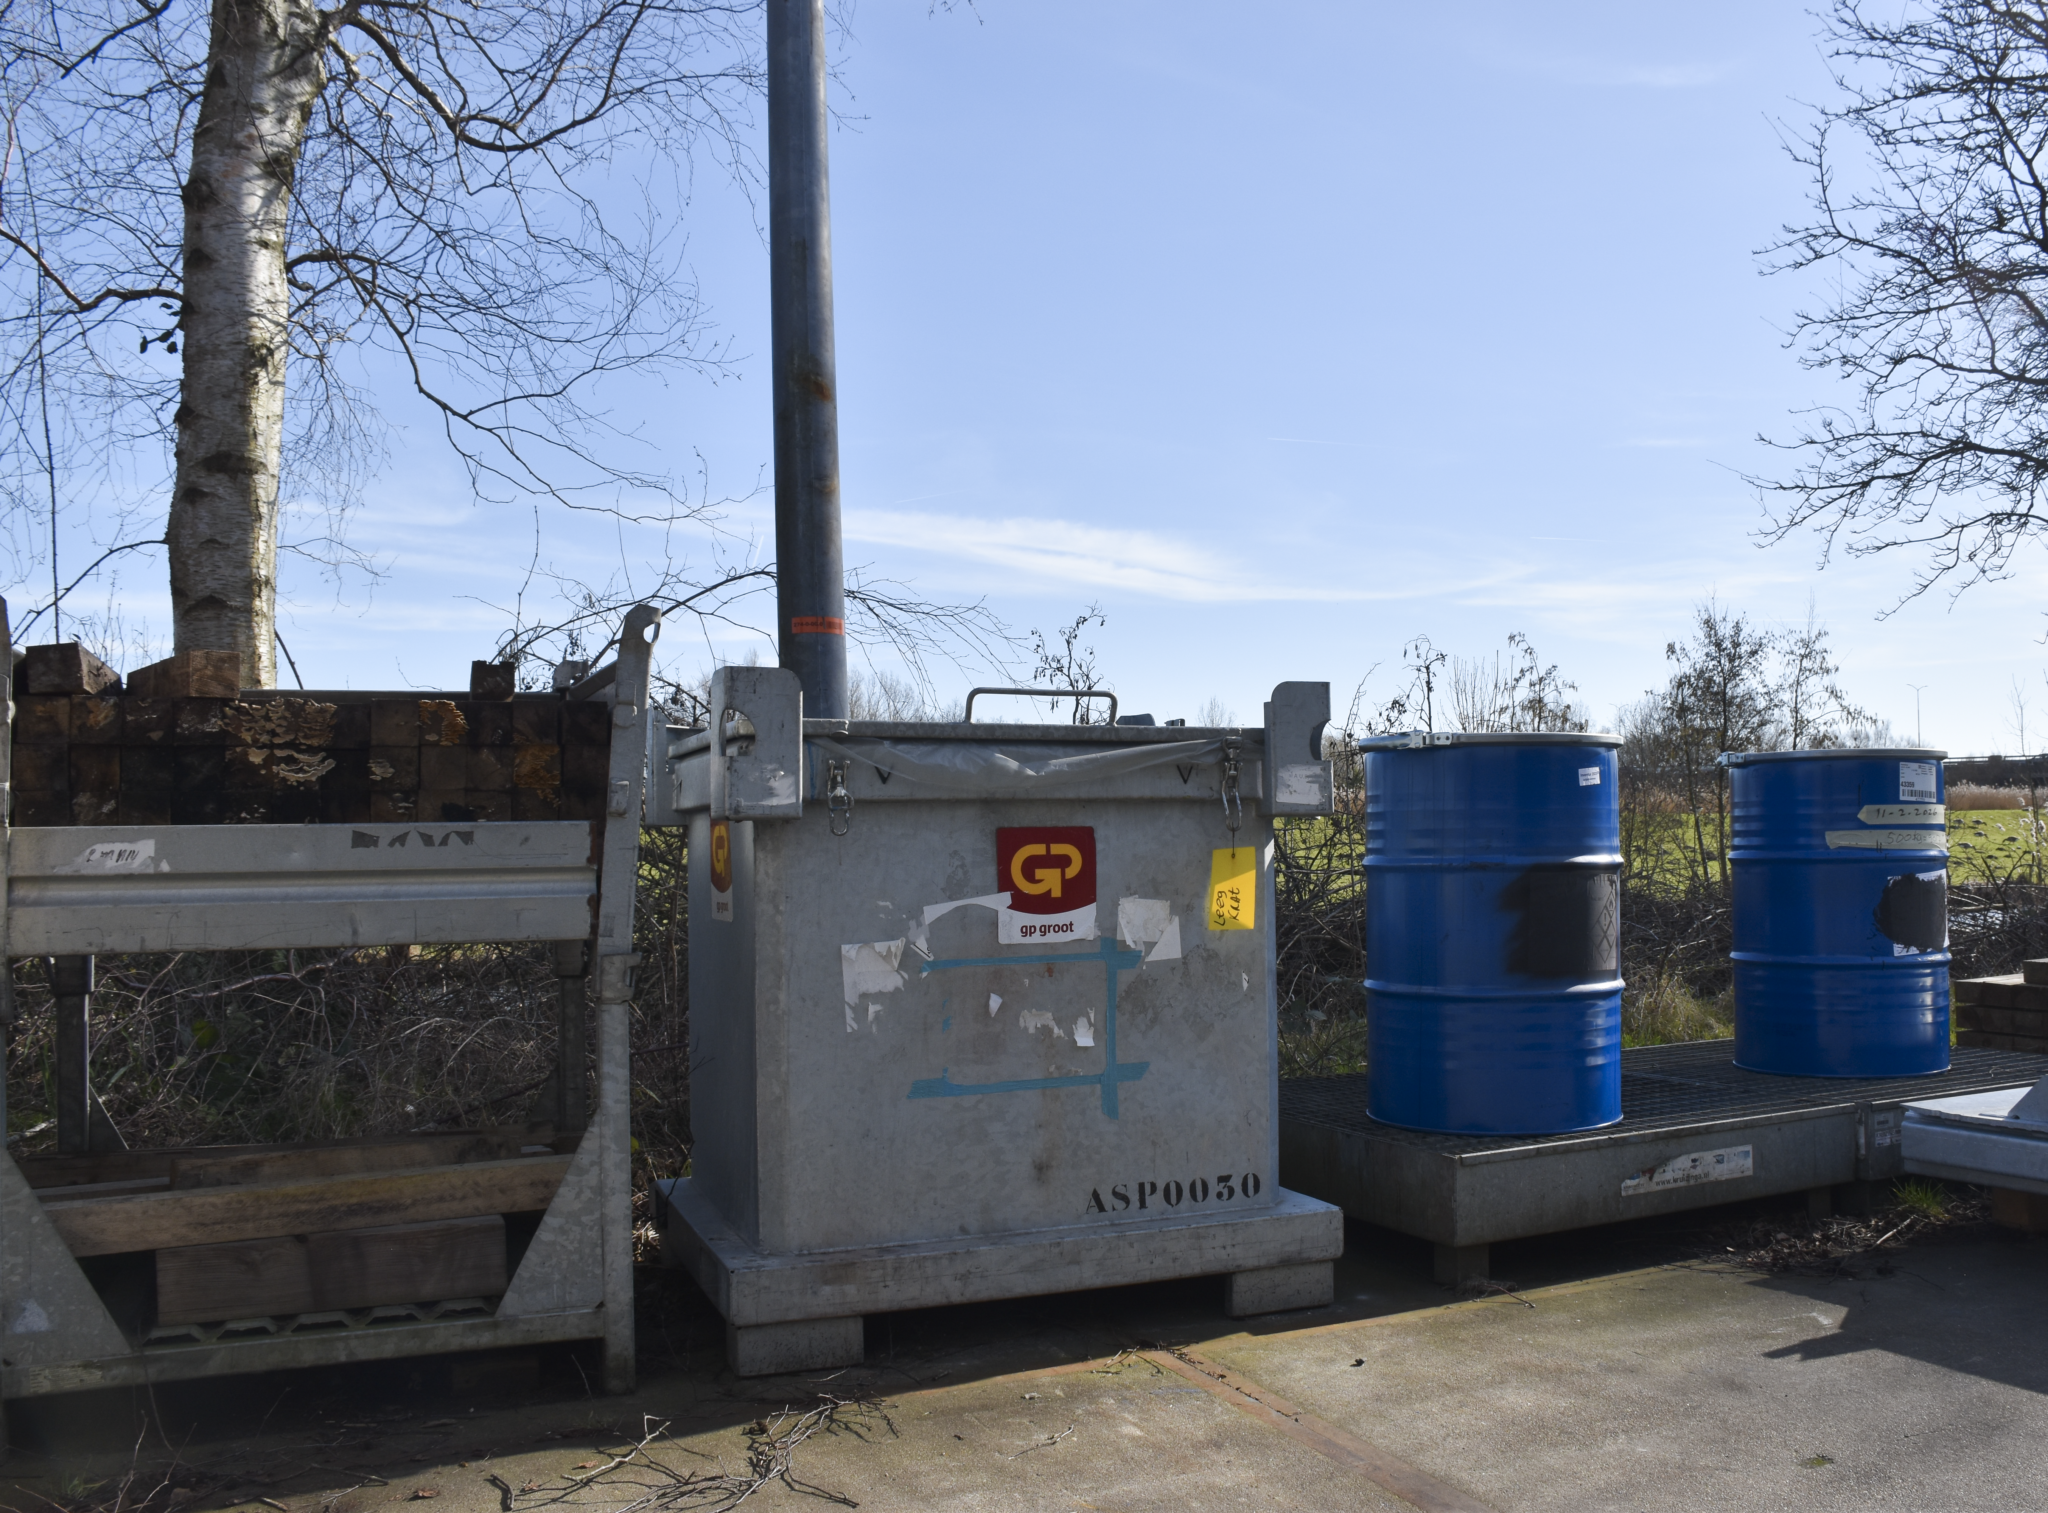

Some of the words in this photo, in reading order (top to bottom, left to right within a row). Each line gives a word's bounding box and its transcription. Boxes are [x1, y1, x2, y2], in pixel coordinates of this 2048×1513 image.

[1010, 843, 1083, 898] GP
[1020, 924, 1037, 937] gp
[1039, 920, 1075, 936] groot
[1085, 1172, 1261, 1215] ASP0030
